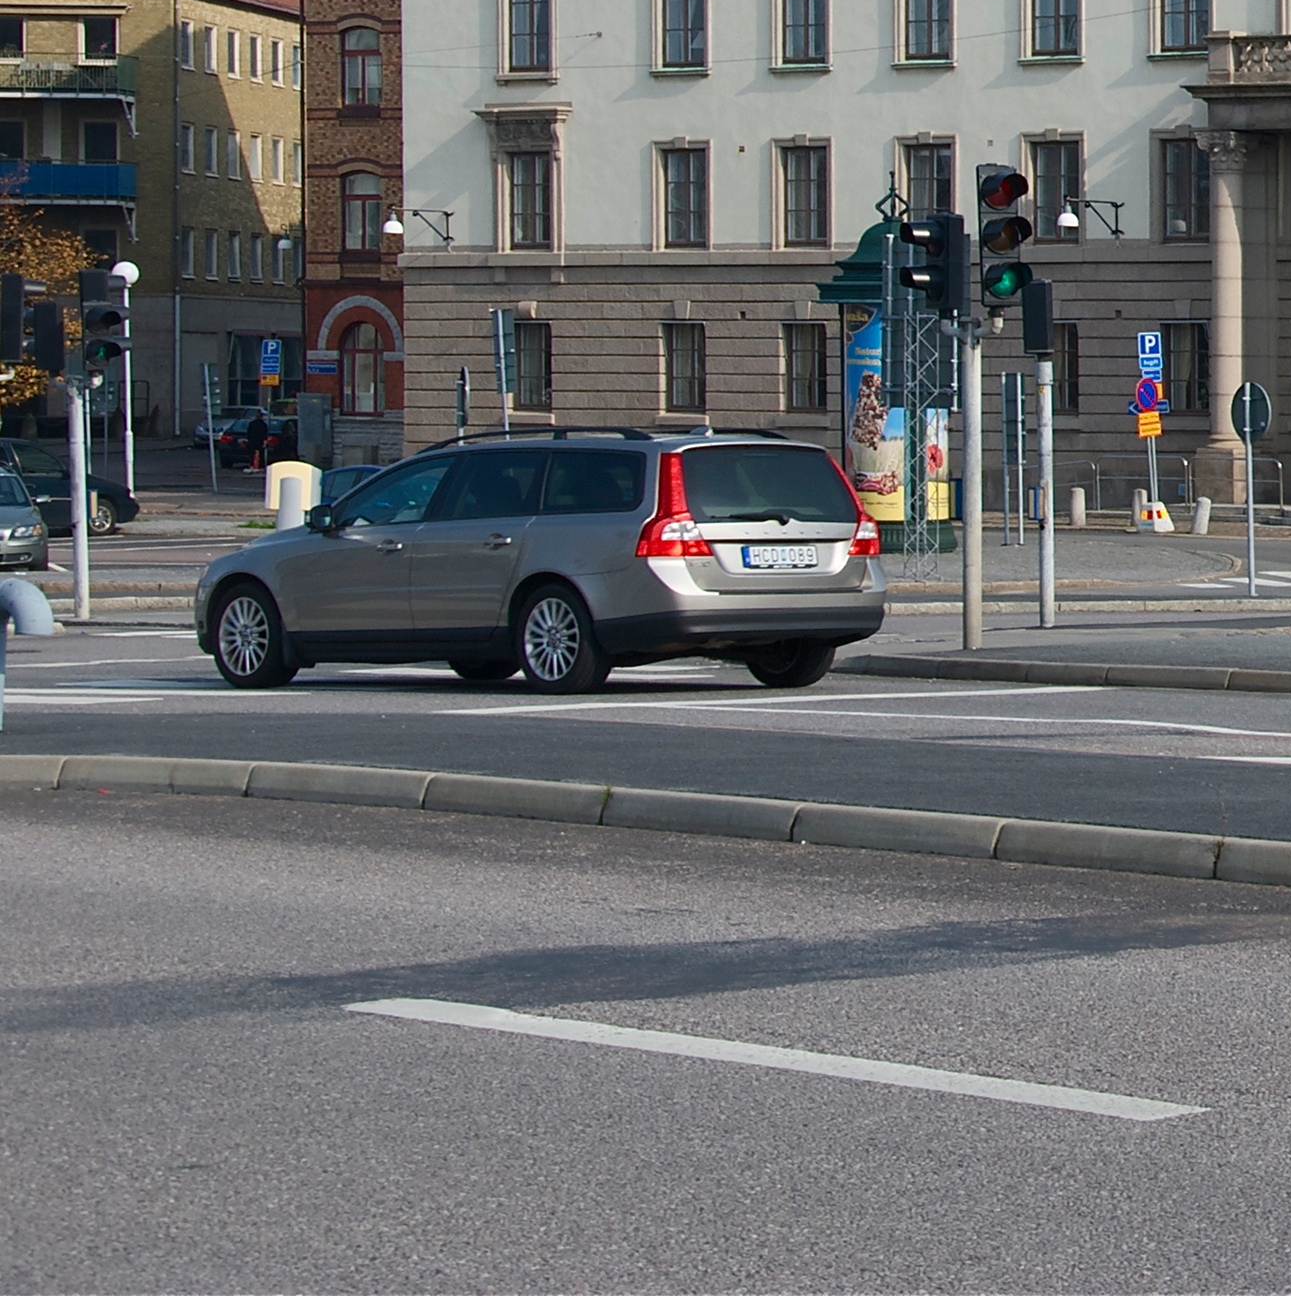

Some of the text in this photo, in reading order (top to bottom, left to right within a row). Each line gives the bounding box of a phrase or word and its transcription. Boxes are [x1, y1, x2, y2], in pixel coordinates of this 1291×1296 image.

[267, 342, 277, 355] P
[1145, 335, 1156, 354] P
[752, 548, 814, 563] HCD 089
